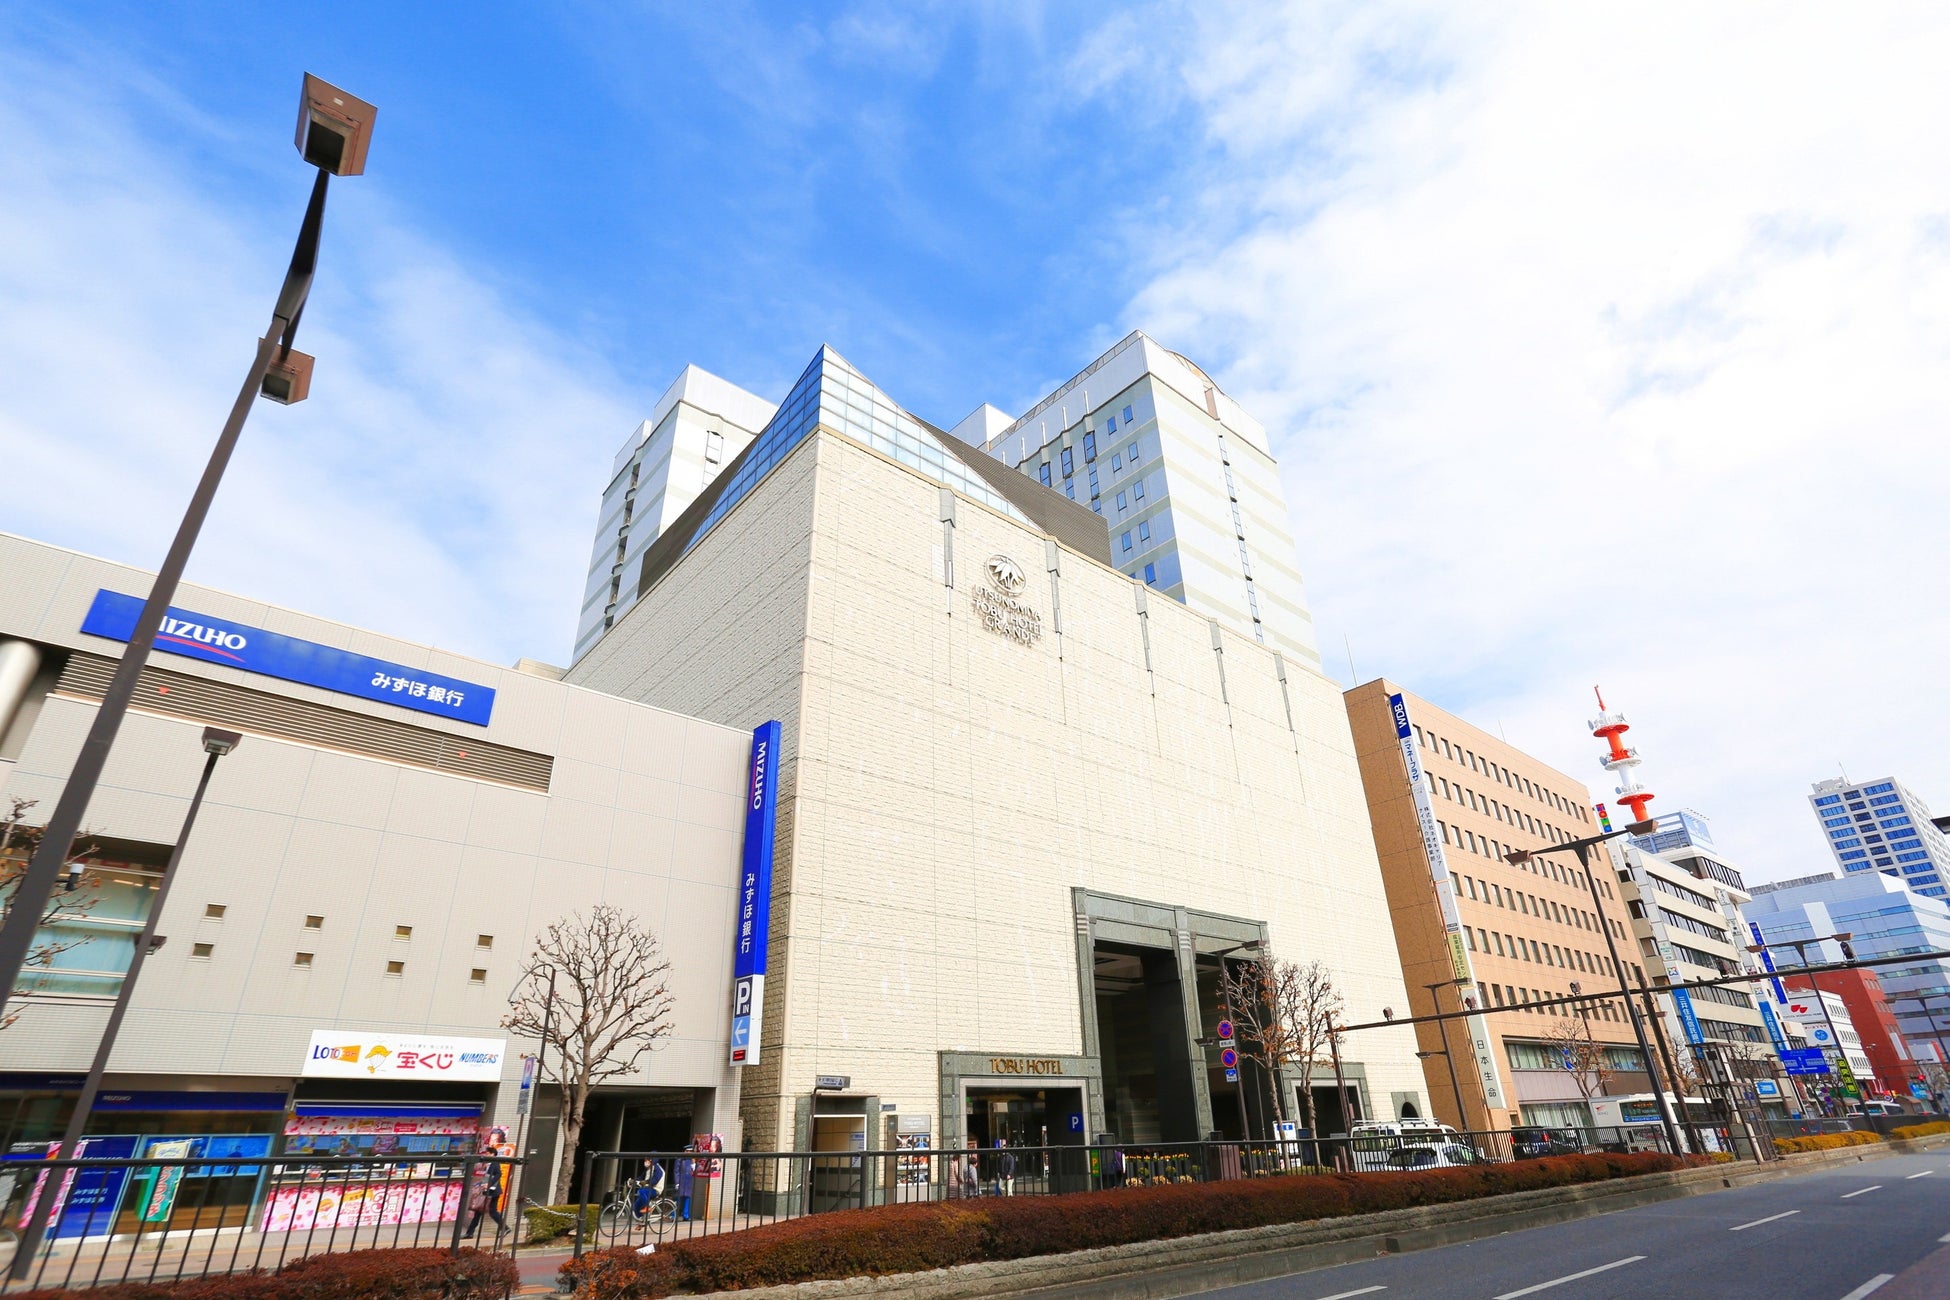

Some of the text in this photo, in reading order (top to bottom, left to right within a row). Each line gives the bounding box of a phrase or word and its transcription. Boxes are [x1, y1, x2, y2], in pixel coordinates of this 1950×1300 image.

[974, 585, 1041, 621] UTSUNOMIYA
[974, 599, 1041, 635] TOBU HOTEL
[159, 615, 247, 650] IZUHO
[984, 615, 1037, 643] GRANDE
[371, 671, 465, 707] みずほ銀行
[1394, 702, 1407, 729] WDB
[753, 741, 767, 810] MIZUHO
[741, 872, 755, 954] みずほ銀行
[736, 981, 751, 1015] P
[742, 1003, 750, 1014] IN
[313, 1044, 344, 1060] LOTO
[396, 1051, 454, 1070] 宝くじ
[457, 1051, 499, 1064] NUMBERS
[990, 1058, 1063, 1075] TOBU HOTEL
[1476, 1040, 1498, 1098] 日本生命
[1071, 1116, 1080, 1129] P
